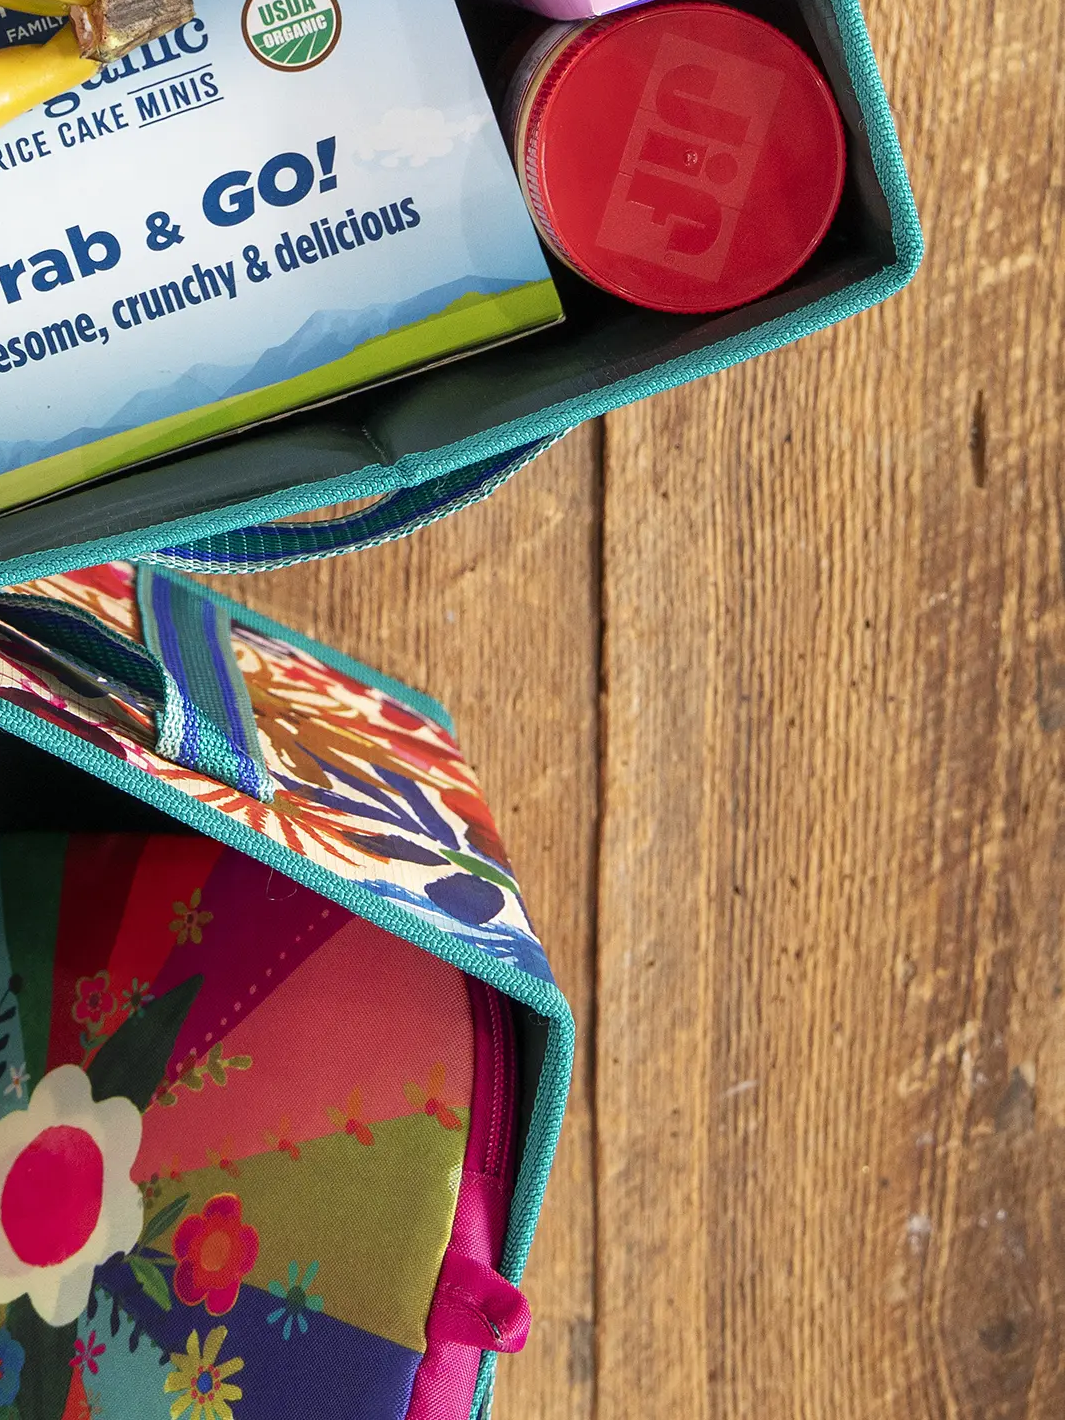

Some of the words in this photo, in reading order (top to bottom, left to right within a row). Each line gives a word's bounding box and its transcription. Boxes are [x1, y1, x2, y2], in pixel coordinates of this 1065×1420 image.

[6, 16, 64, 43] FAMILY
[262, 14, 328, 48] ORGANIC
[57, 103, 129, 149] CAKE
[135, 72, 219, 121] MINIS
[146, 211, 185, 252] &
[202, 136, 338, 227] GO!
[112, 259, 238, 330] crunchy
[243, 244, 272, 284] &
[274, 197, 421, 273] delicious
